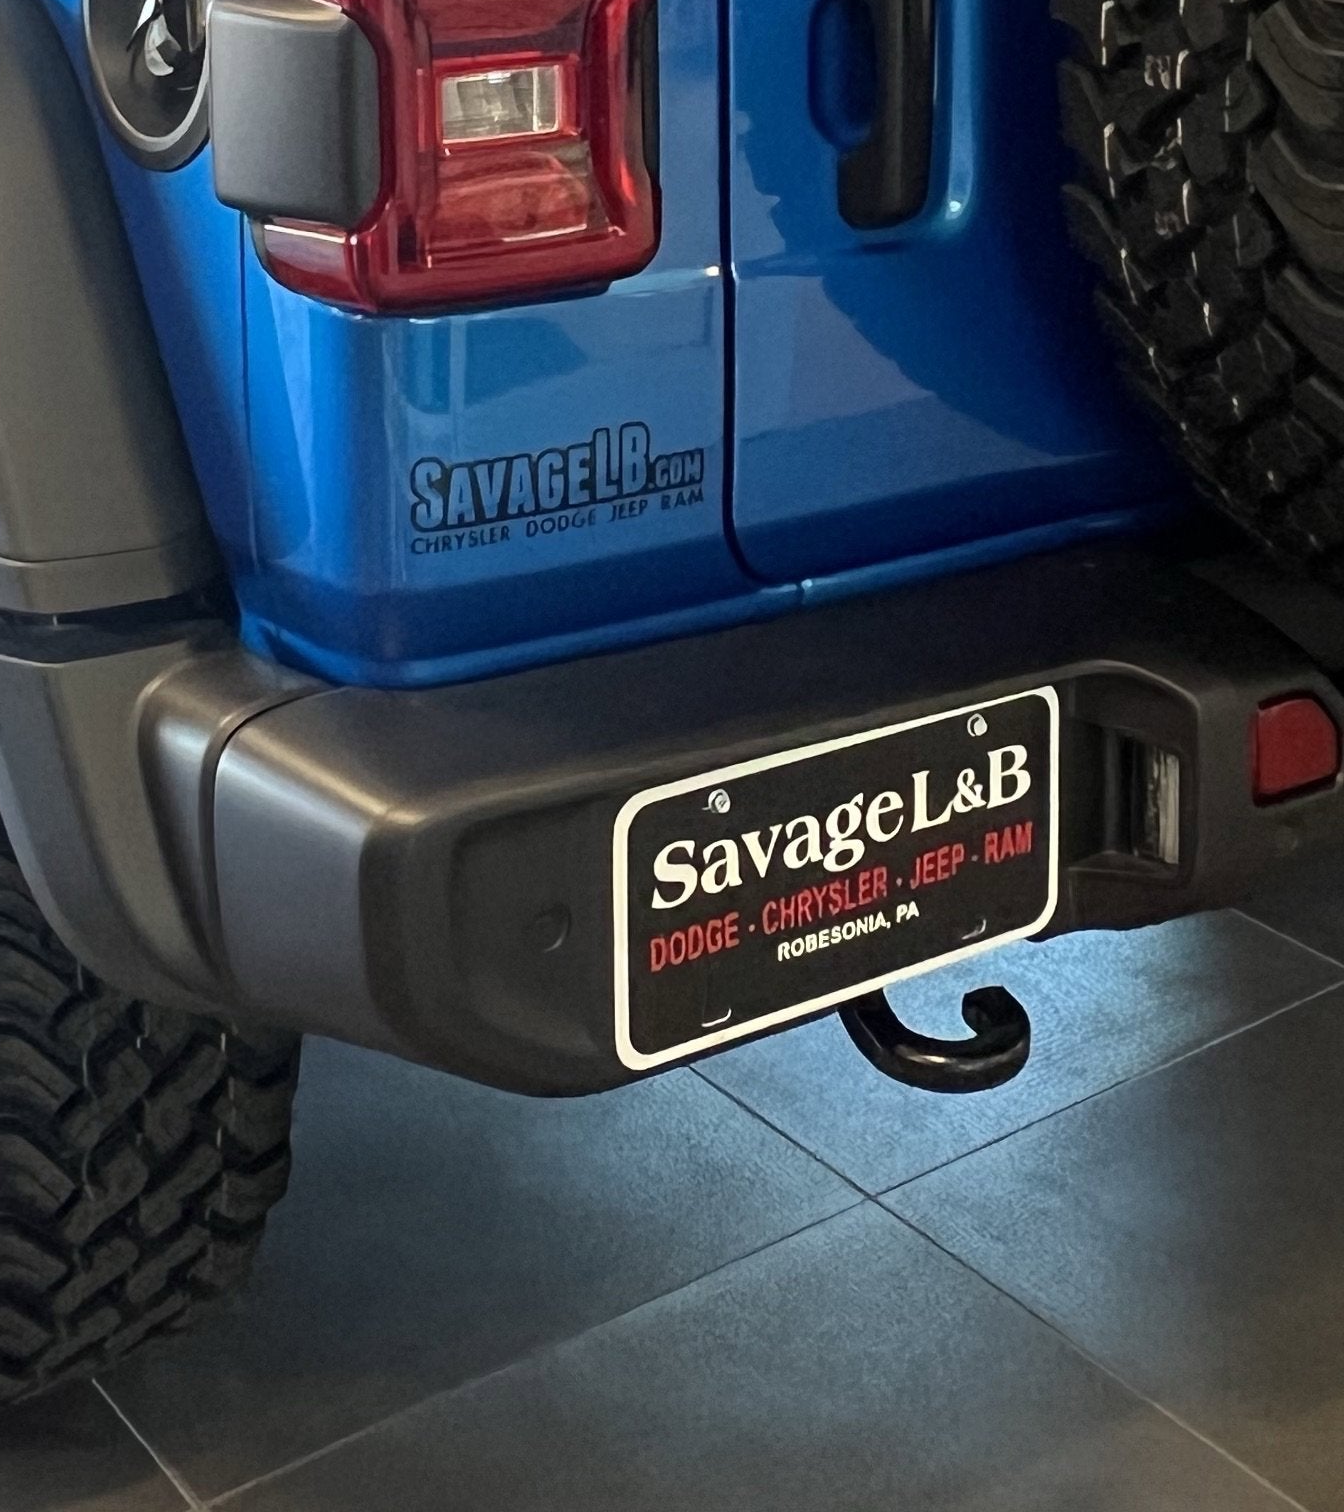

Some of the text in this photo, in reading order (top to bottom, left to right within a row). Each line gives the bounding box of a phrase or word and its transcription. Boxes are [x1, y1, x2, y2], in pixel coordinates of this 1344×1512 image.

[411, 488, 704, 555] CHRYSLER DODGE JEEP RAM
[649, 821, 1033, 973] DODGE CHRYSLER JEEP RAM
[777, 900, 919, 962] ROBESONIA, PA
